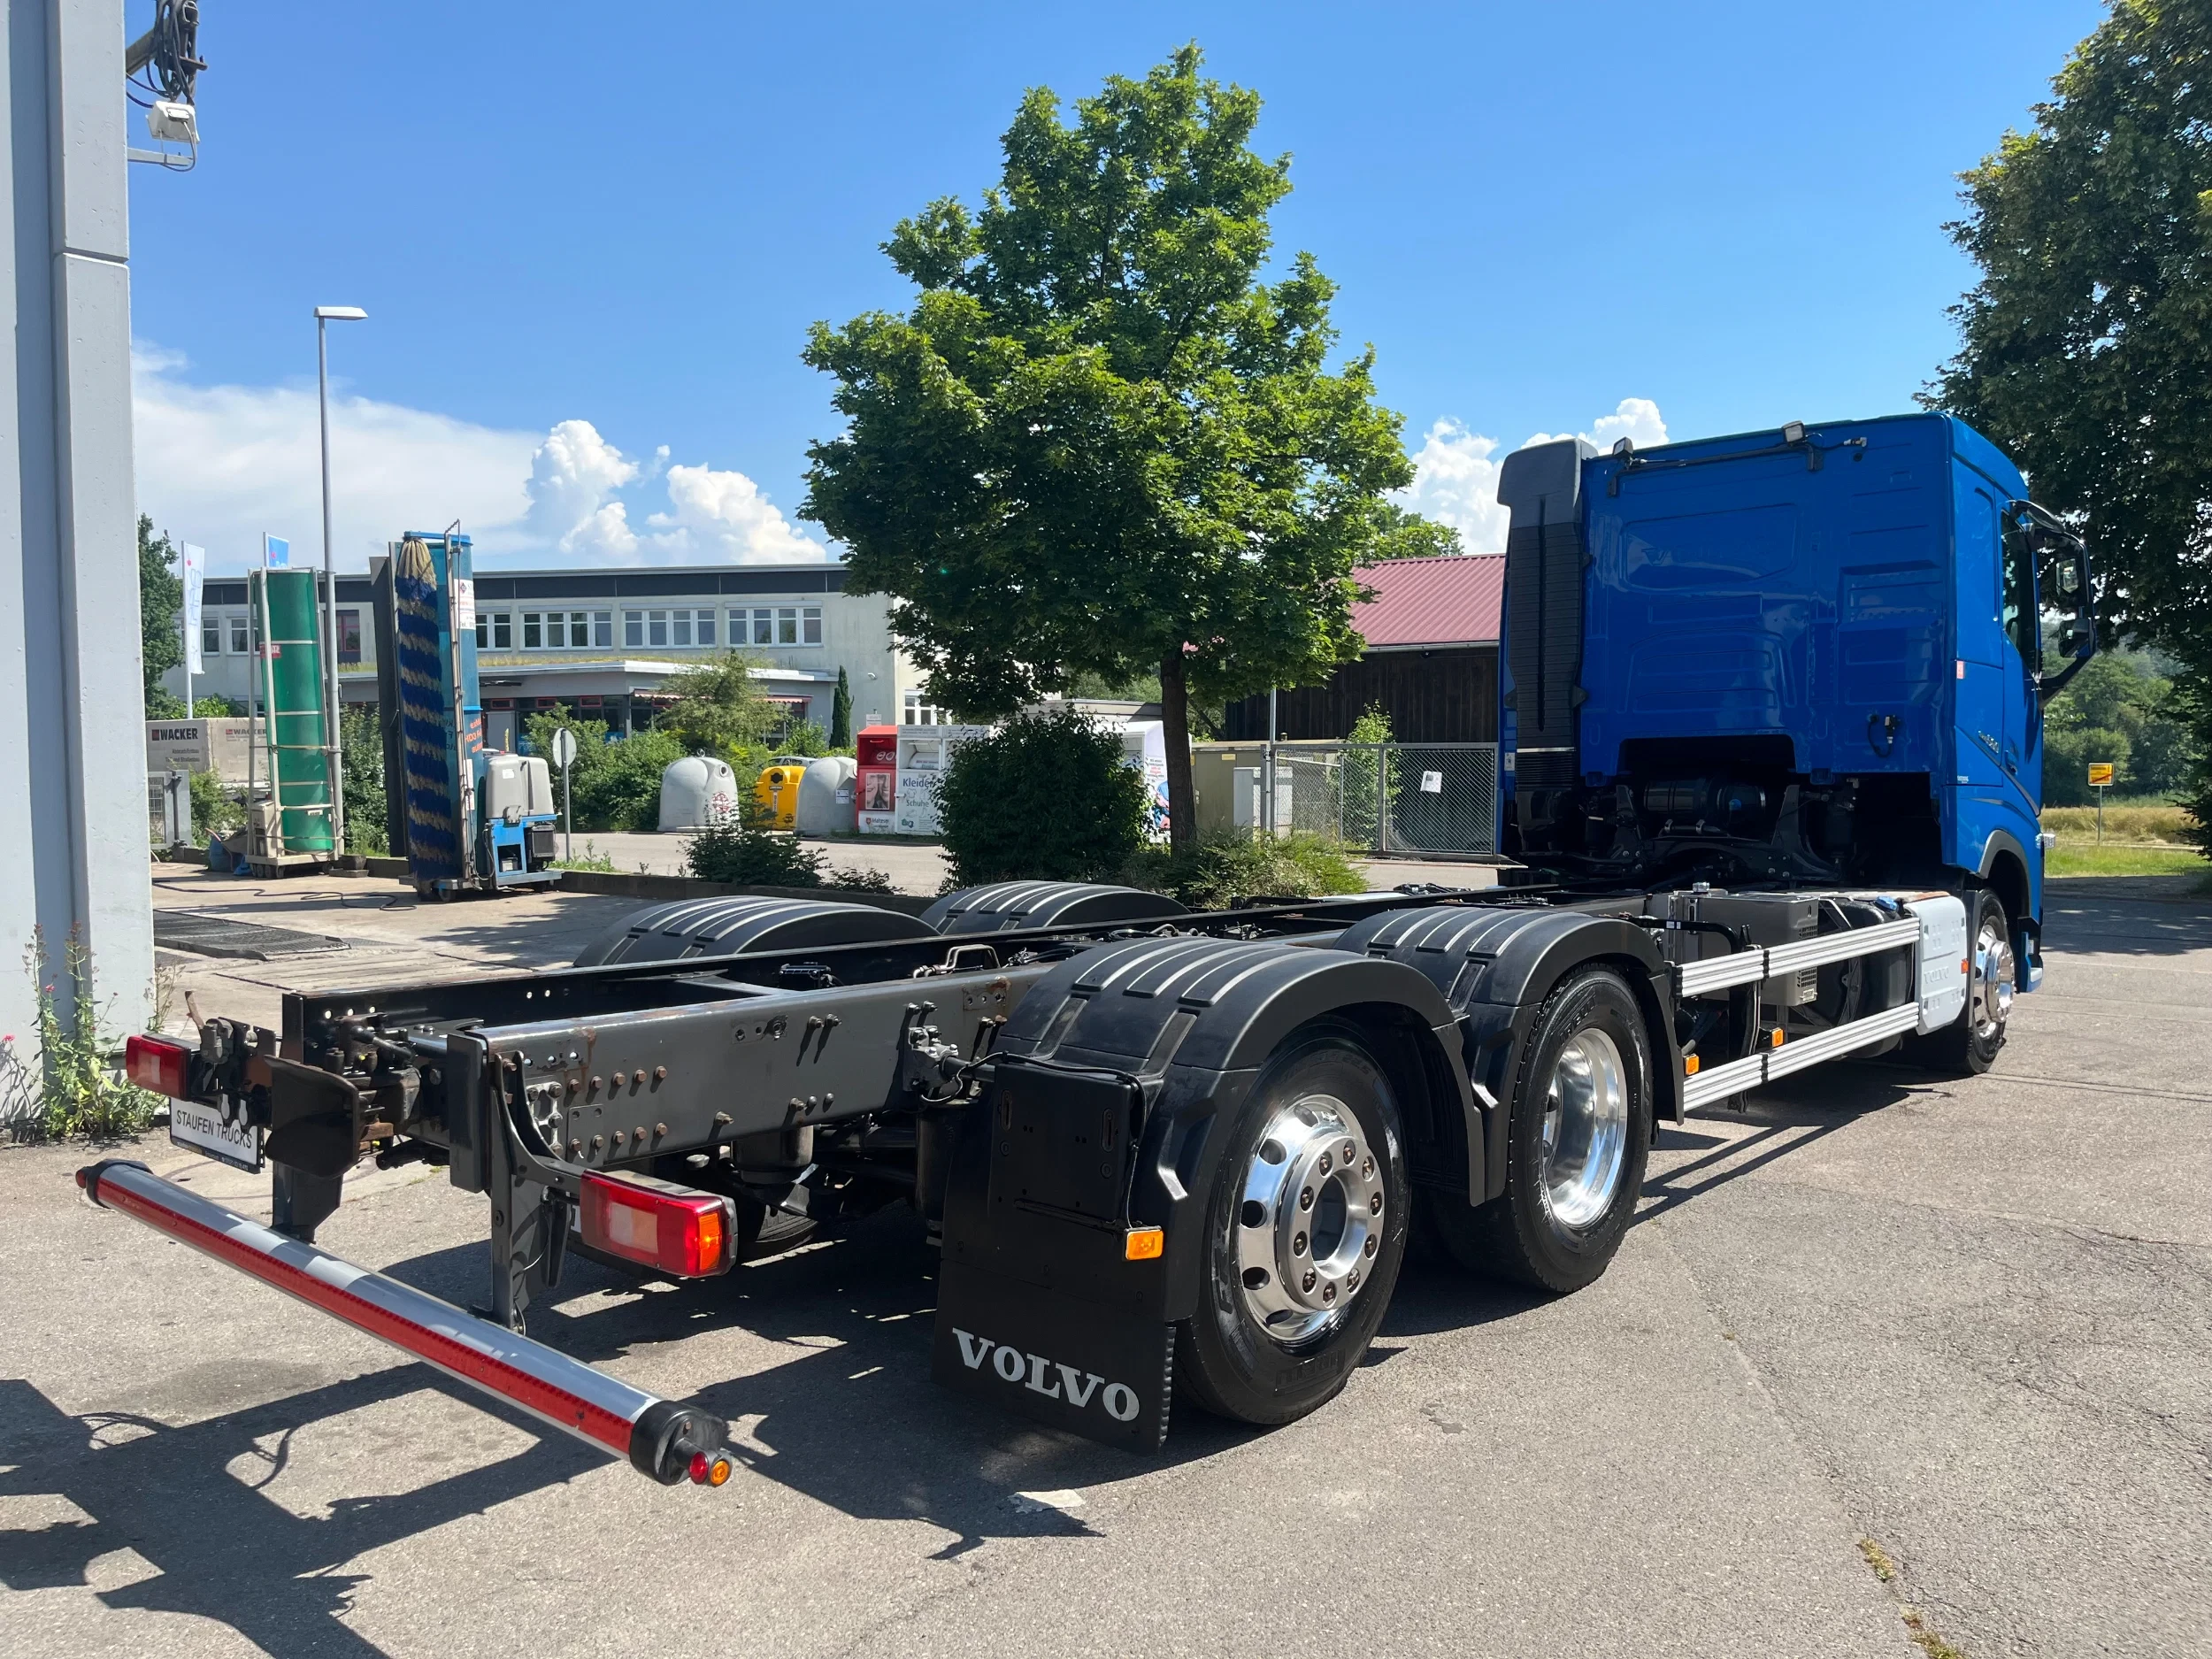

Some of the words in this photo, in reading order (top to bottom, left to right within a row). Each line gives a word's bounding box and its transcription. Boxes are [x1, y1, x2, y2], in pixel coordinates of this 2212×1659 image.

[160, 728, 198, 741] WACKER
[176, 1109, 214, 1136] STAUFEN
[216, 1122, 253, 1149] TRUCKS
[952, 1327, 1140, 1422] VOLVO
